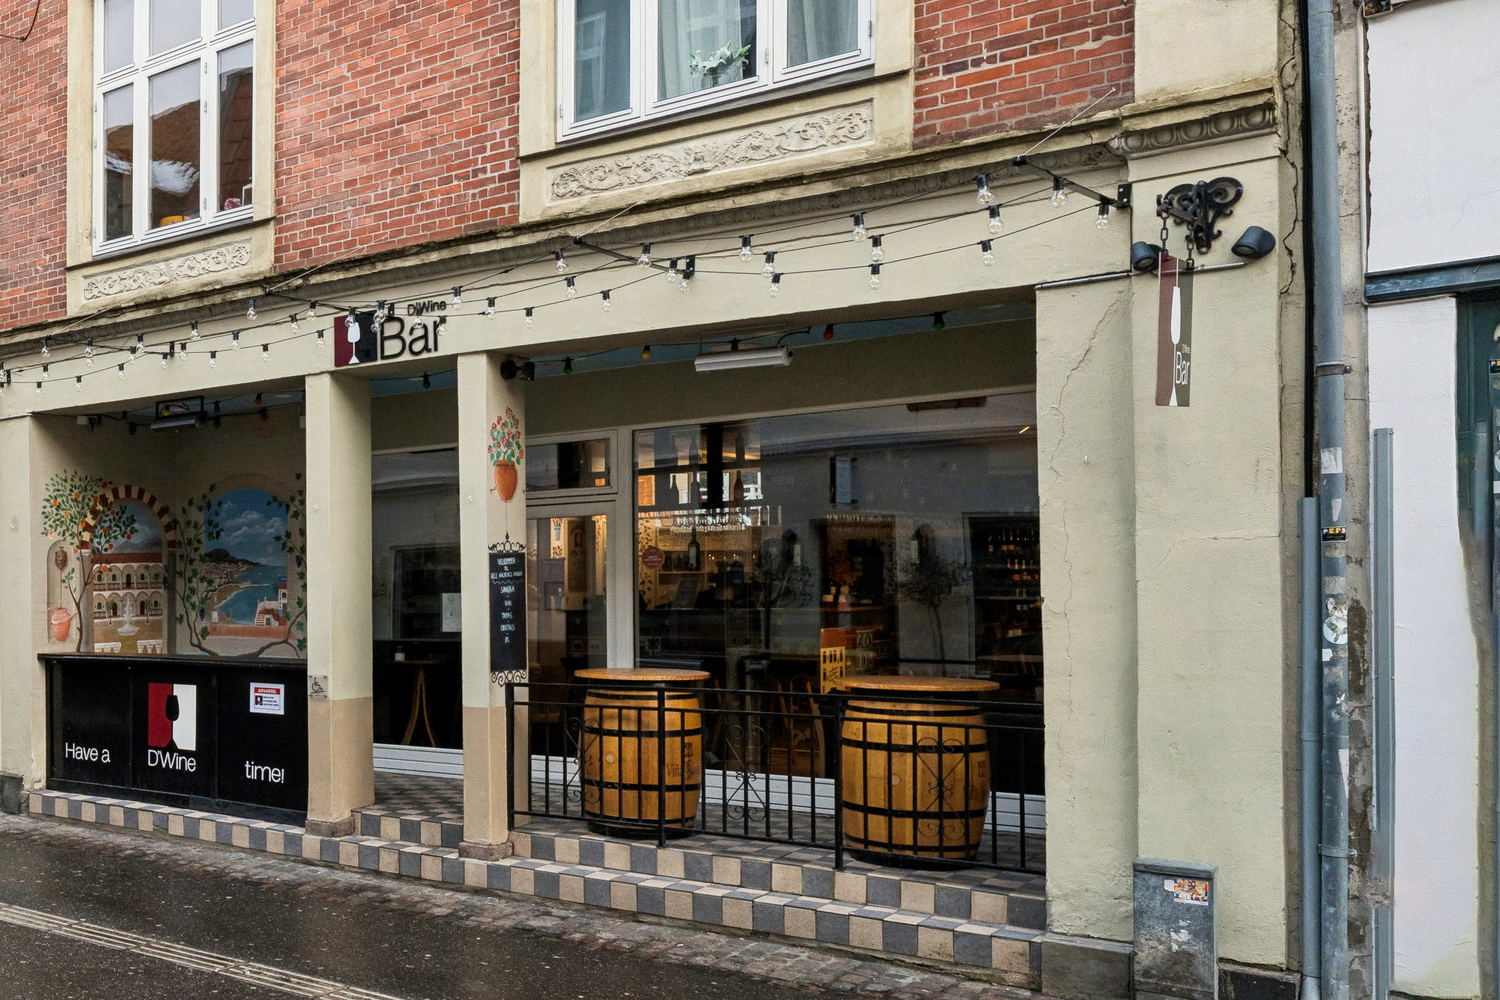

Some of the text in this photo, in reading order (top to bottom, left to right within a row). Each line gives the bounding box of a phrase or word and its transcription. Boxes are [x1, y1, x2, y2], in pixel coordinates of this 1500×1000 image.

[380, 316, 440, 360] Bar
[1175, 351, 1190, 385] Bar
[64, 742, 111, 763] Have a
[147, 749, 196, 772] D'Wine
[244, 760, 285, 784] time!
